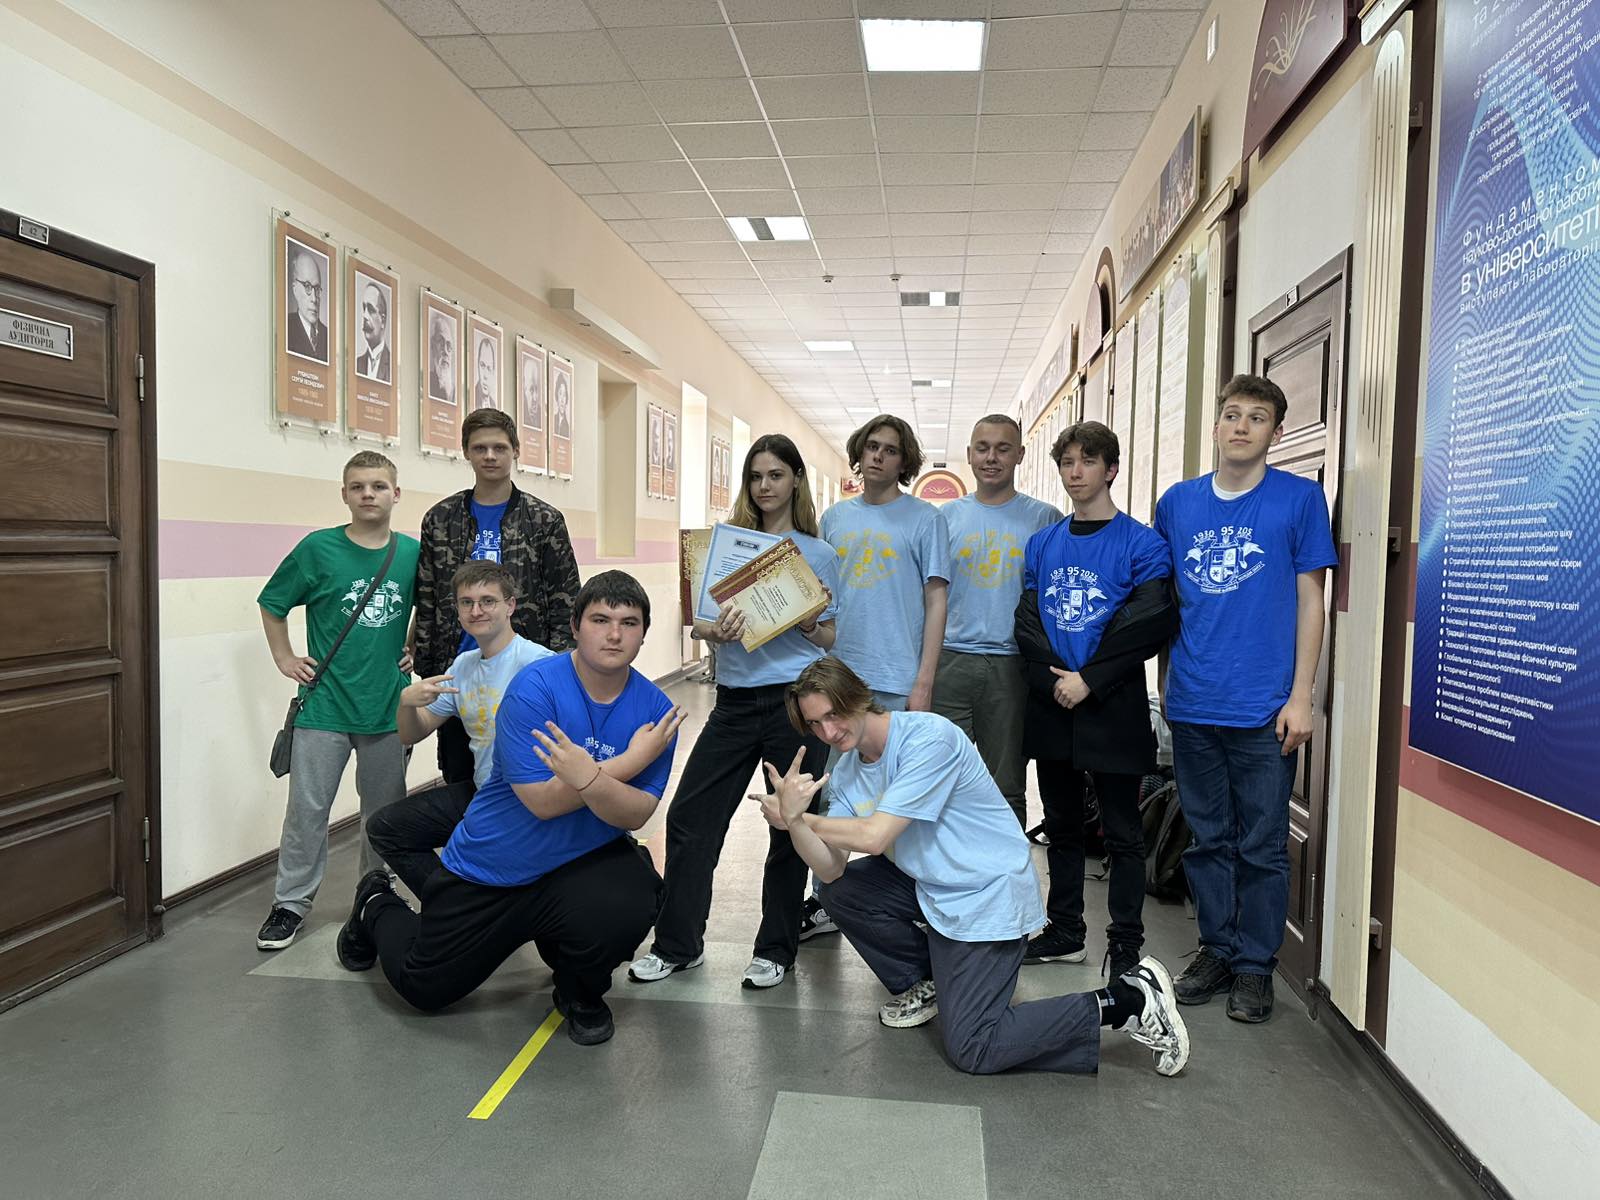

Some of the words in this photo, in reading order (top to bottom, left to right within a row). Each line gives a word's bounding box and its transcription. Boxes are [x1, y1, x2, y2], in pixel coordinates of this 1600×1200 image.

[1461, 273, 1470, 295] в
[1476, 195, 1600, 295] університеті
[1460, 281, 1519, 314] виступають
[12, 319, 50, 337] ФІЗИЧНА
[8, 331, 54, 349] АУДИТОРІЯ
[482, 529, 494, 539] 95
[1221, 525, 1234, 536] 95
[1559, 528, 1572, 538] віку
[1067, 566, 1079, 576] 95
[1080, 569, 1099, 581] 2025
[1536, 573, 1548, 581] мов
[1527, 599, 1554, 609] простору
[1561, 601, 1578, 610] освіті
[1558, 644, 1576, 655] освіти
[1548, 658, 1576, 672] культури
